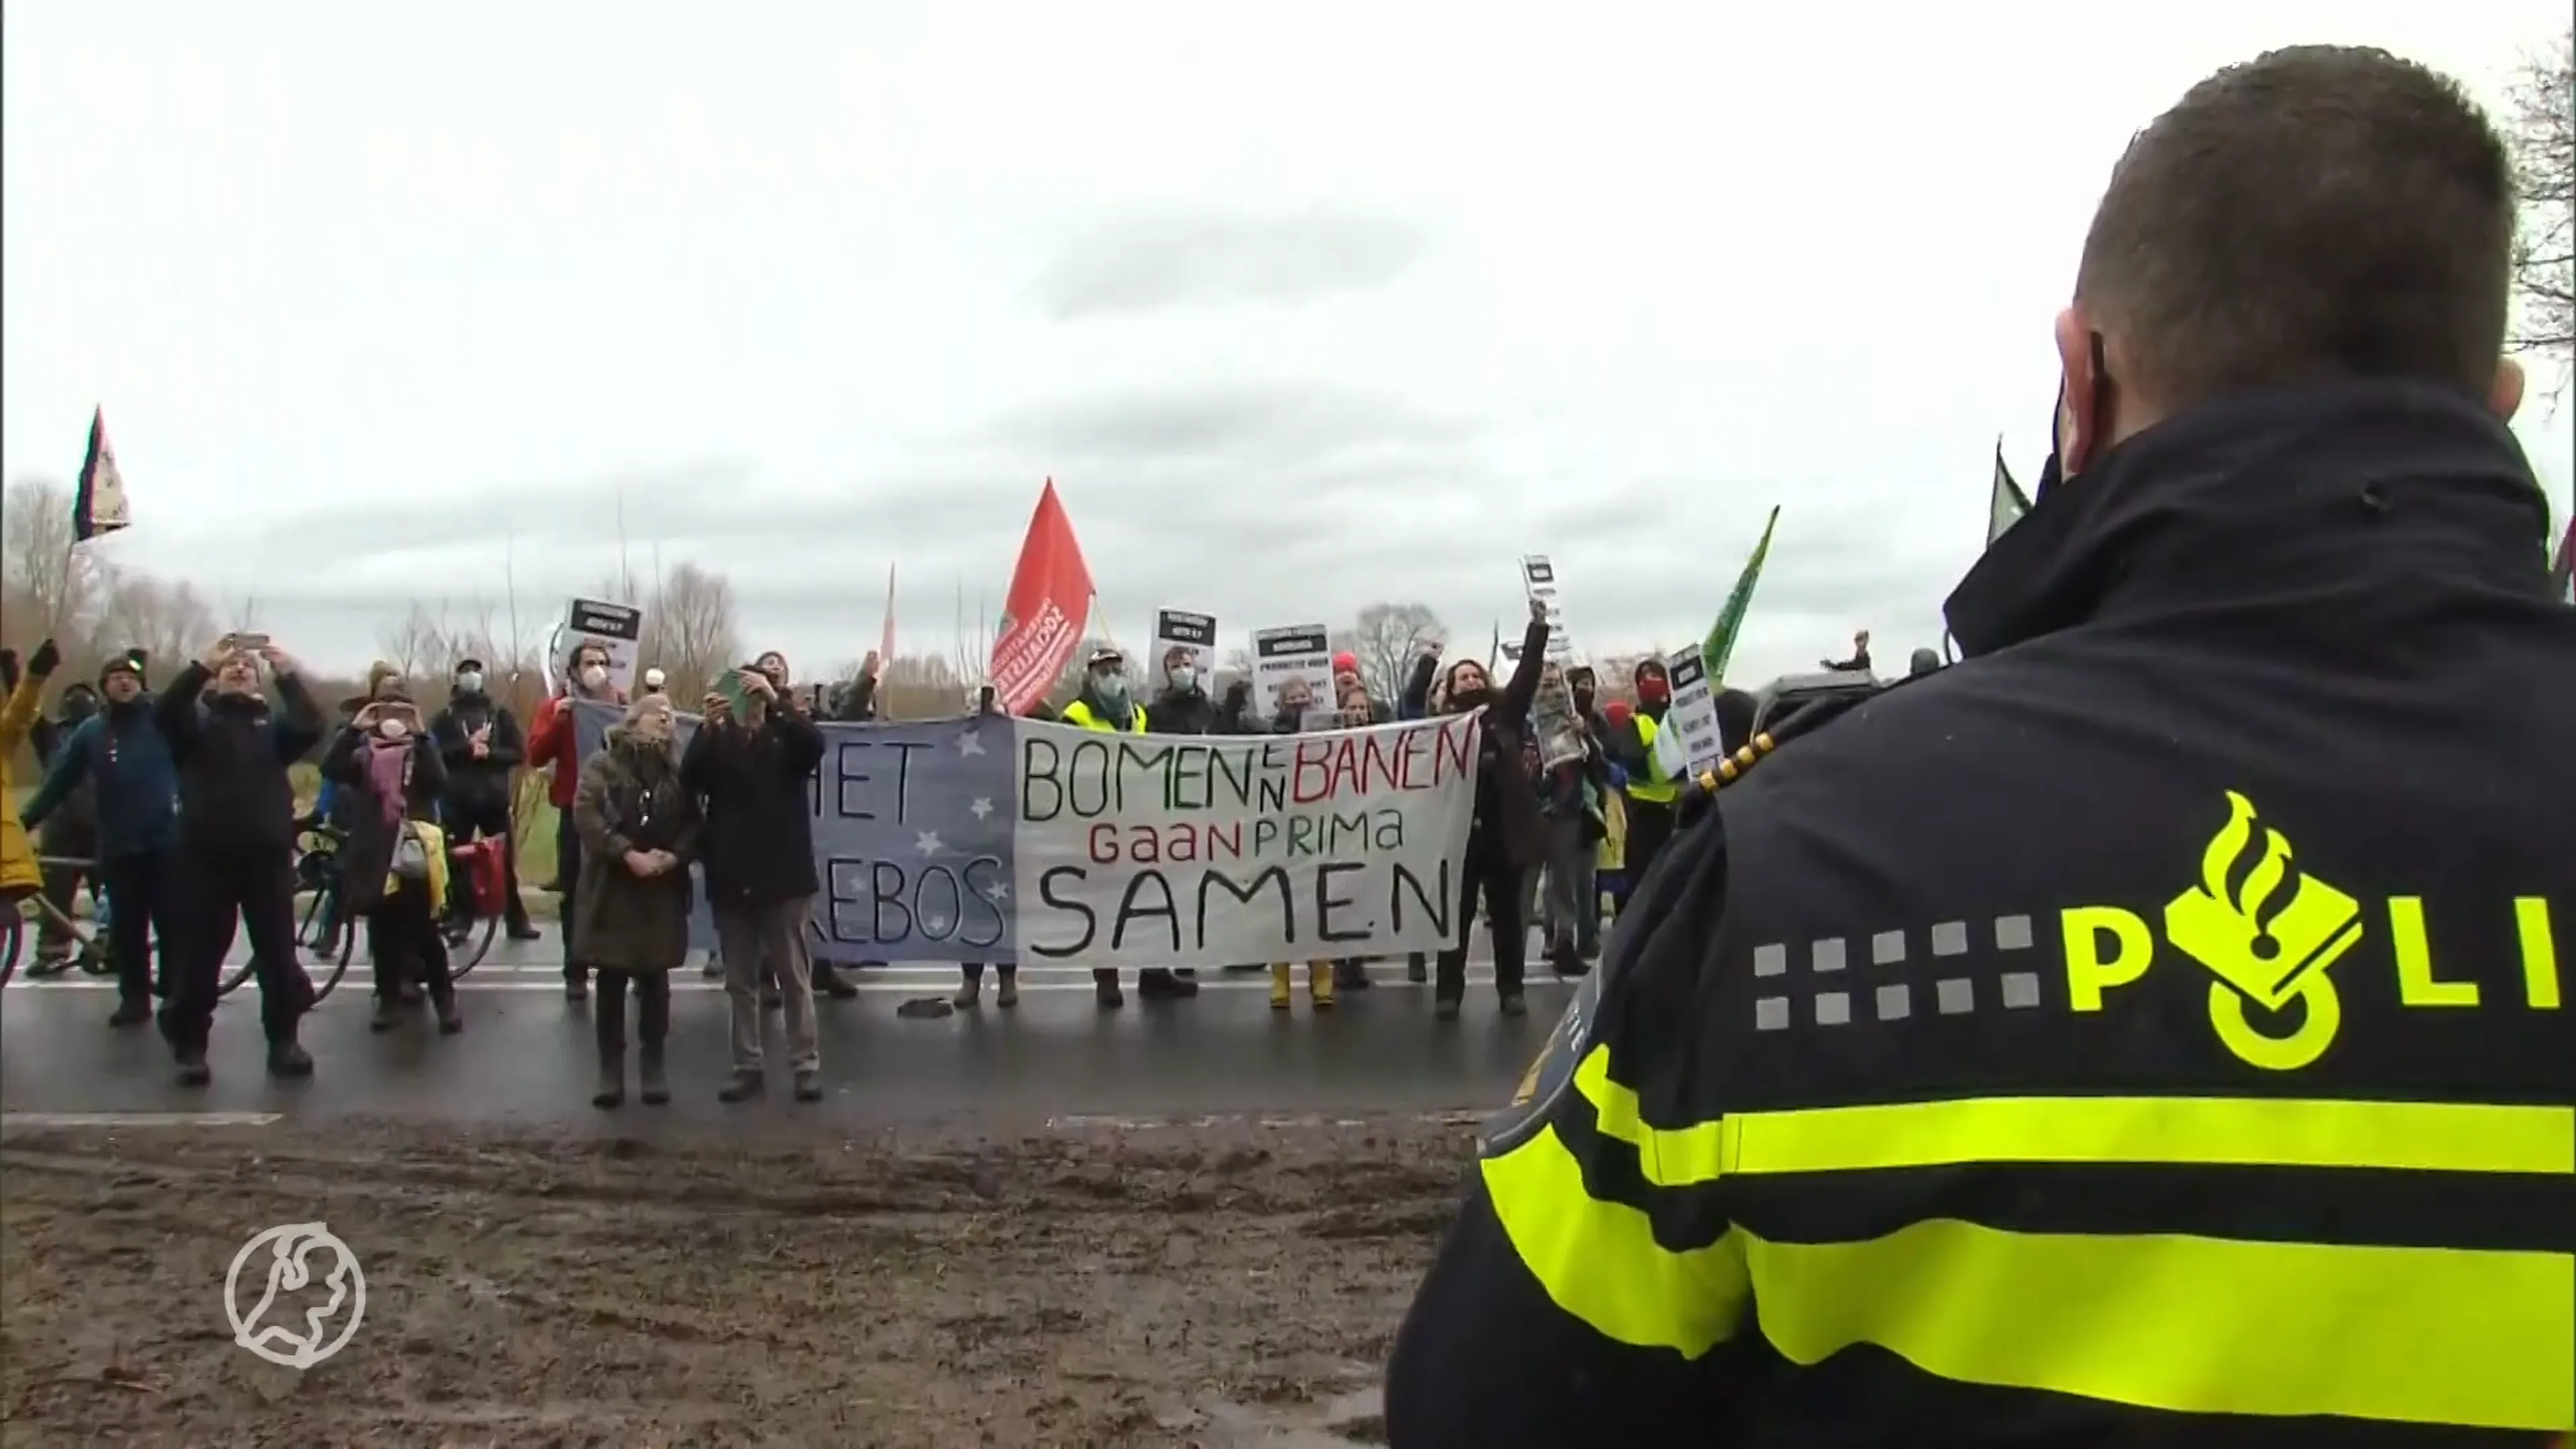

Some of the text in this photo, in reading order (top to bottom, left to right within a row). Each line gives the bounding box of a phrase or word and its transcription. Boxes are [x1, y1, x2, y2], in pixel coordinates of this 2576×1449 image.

[1022, 738, 1254, 822] BOMEN
[1292, 715, 1475, 803] BANEN
[810, 855, 1004, 948] EBOS
[1030, 859, 1450, 958] SAMEN
